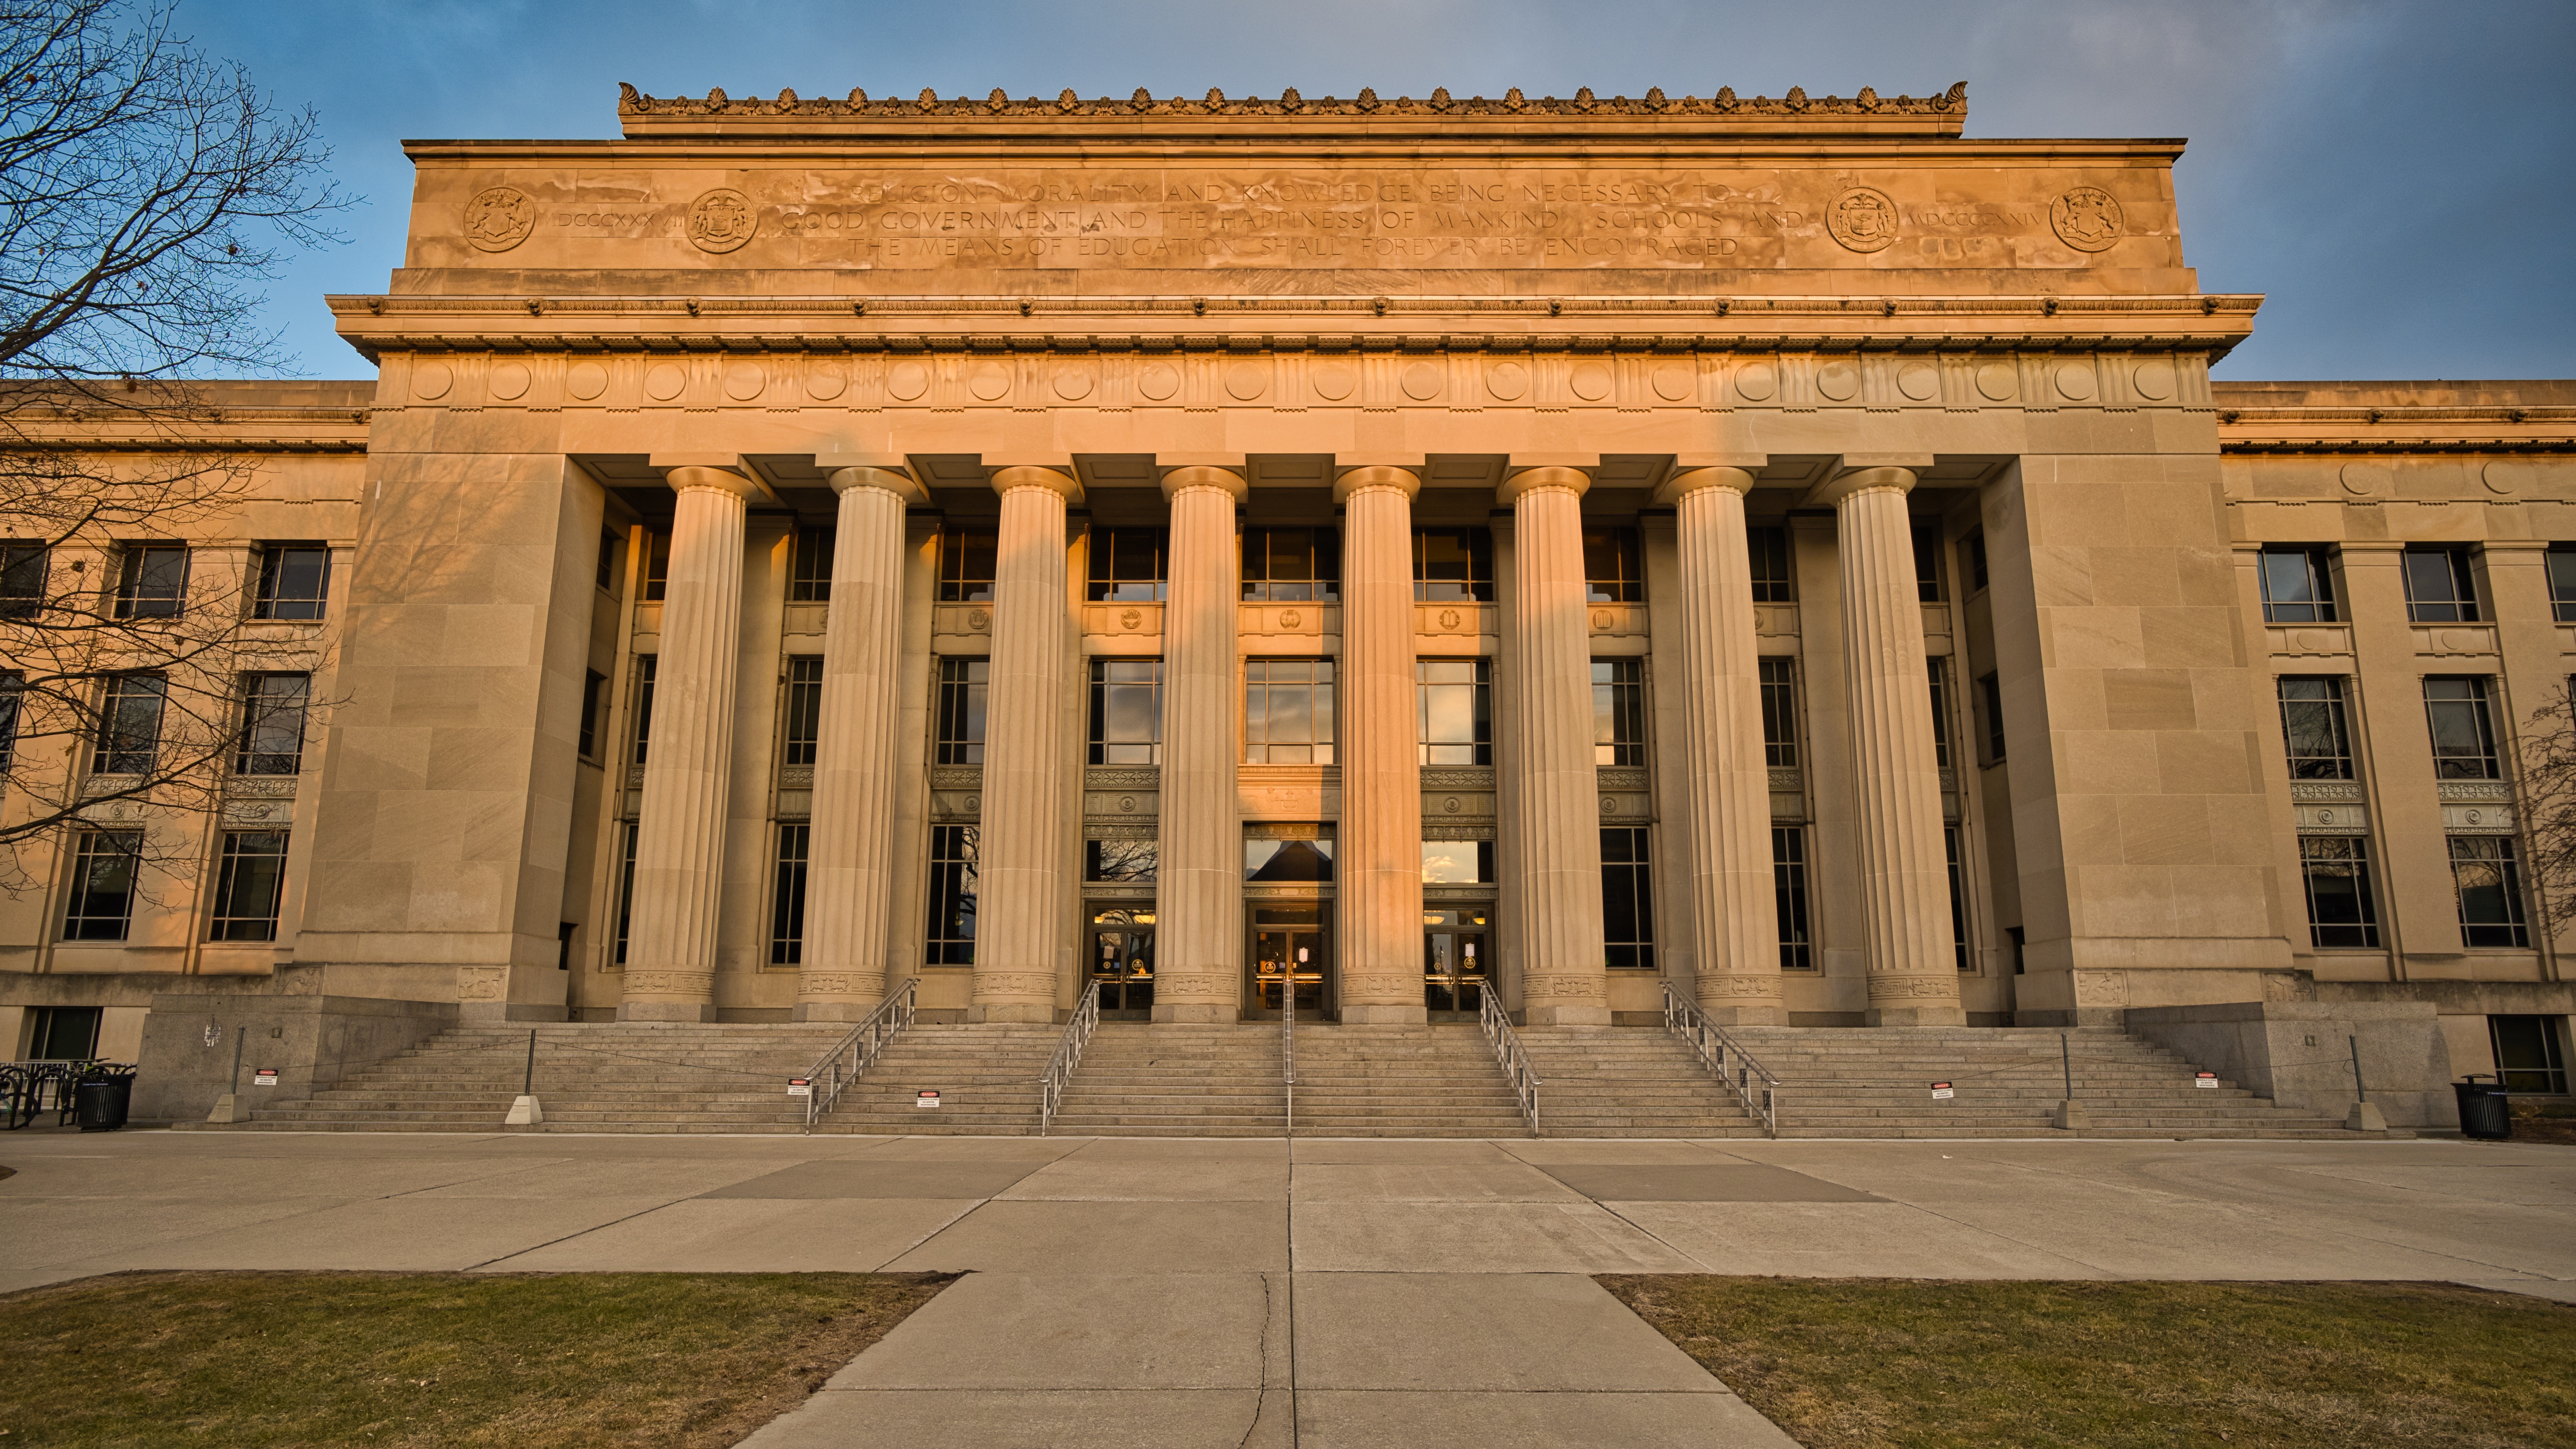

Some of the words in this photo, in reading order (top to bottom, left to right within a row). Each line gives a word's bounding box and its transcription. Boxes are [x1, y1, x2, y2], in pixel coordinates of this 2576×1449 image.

[850, 185, 978, 202] RELIGION
[1000, 185, 1149, 202] MORALITY
[1165, 185, 1224, 201] AND
[1241, 185, 1412, 202] KNOWLEDGE
[1430, 185, 1504, 201] BEING
[1522, 185, 1674, 201] NECESSARY
[1693, 185, 1730, 201] TO
[688, 192, 715, 221] UNIVERSITY
[538, 213, 683, 227] MDCCCXXXVII
[781, 212, 864, 229] GOOD
[881, 211, 1076, 228] GOVERNMENT
[1088, 211, 1147, 228] AND
[1158, 211, 1206, 228] THE
[1220, 211, 1364, 229] HAPPINESS
[1382, 211, 1415, 228] OF
[1432, 211, 1558, 228] MANKIND
[1596, 211, 1722, 228] SCHOOLS
[1745, 211, 1803, 228] AND
[1906, 213, 2043, 226] MDCCCCXXIV
[847, 238, 901, 256] THE
[917, 238, 1013, 256] MEANS
[1028, 238, 1062, 256] OF
[1078, 238, 1238, 256] EDUCATION
[1260, 238, 1342, 256] SHALL
[1361, 238, 1479, 256] FOREVER
[1499, 238, 1526, 255] BE
[1545, 238, 1738, 255] ENCOURAGED
